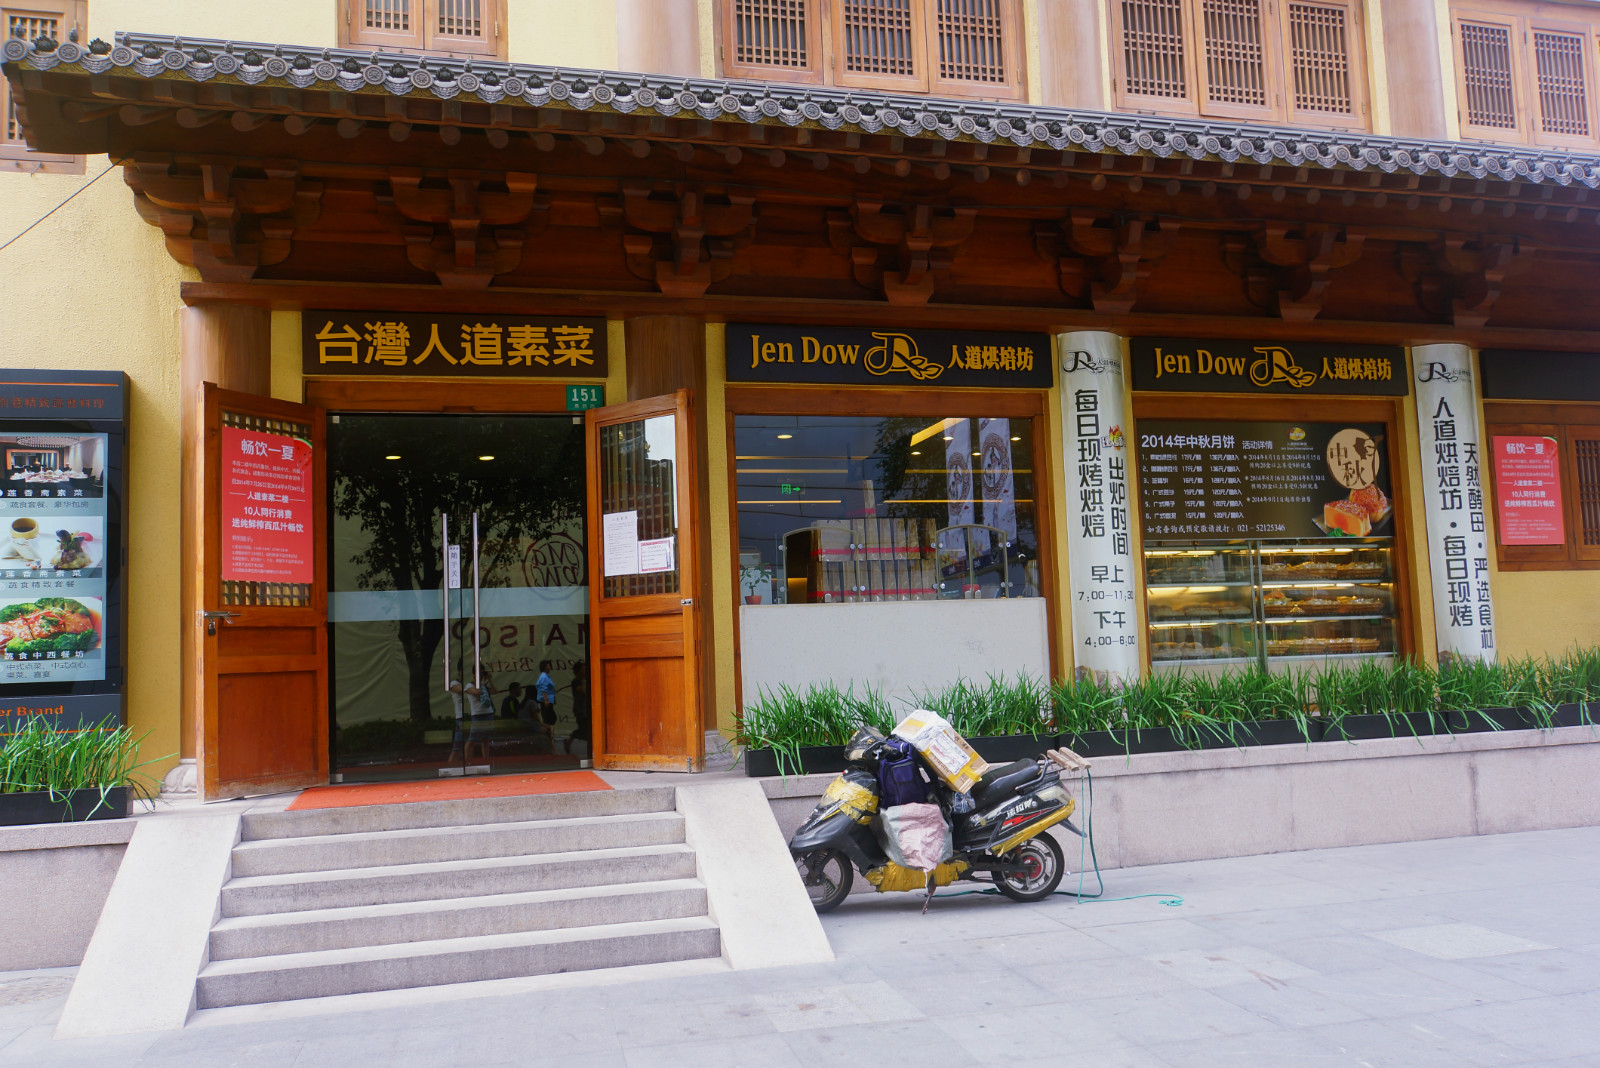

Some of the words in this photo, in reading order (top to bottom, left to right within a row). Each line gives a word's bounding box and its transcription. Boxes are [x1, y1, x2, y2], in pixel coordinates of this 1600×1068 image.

[315, 320, 595, 366] 台灣人道素菜
[751, 334, 795, 369] Jen
[800, 336, 860, 365] Dow
[1154, 347, 1192, 379] Jen
[1196, 349, 1247, 376] Dow
[571, 388, 598, 402] 151
[240, 438, 295, 461] 畅饮一夏
[1141, 434, 1236, 450] 2014年中秋月饼
[1506, 442, 1545, 455] 畅饮一夏
[1074, 389, 1105, 538] 每日现烤烘焙
[243, 506, 293, 520] 10人同行消费
[1108, 456, 1129, 556] 出炉时间
[1091, 564, 1125, 584] 早上
[1093, 611, 1127, 629] 下午
[16, 704, 64, 716] Brand
